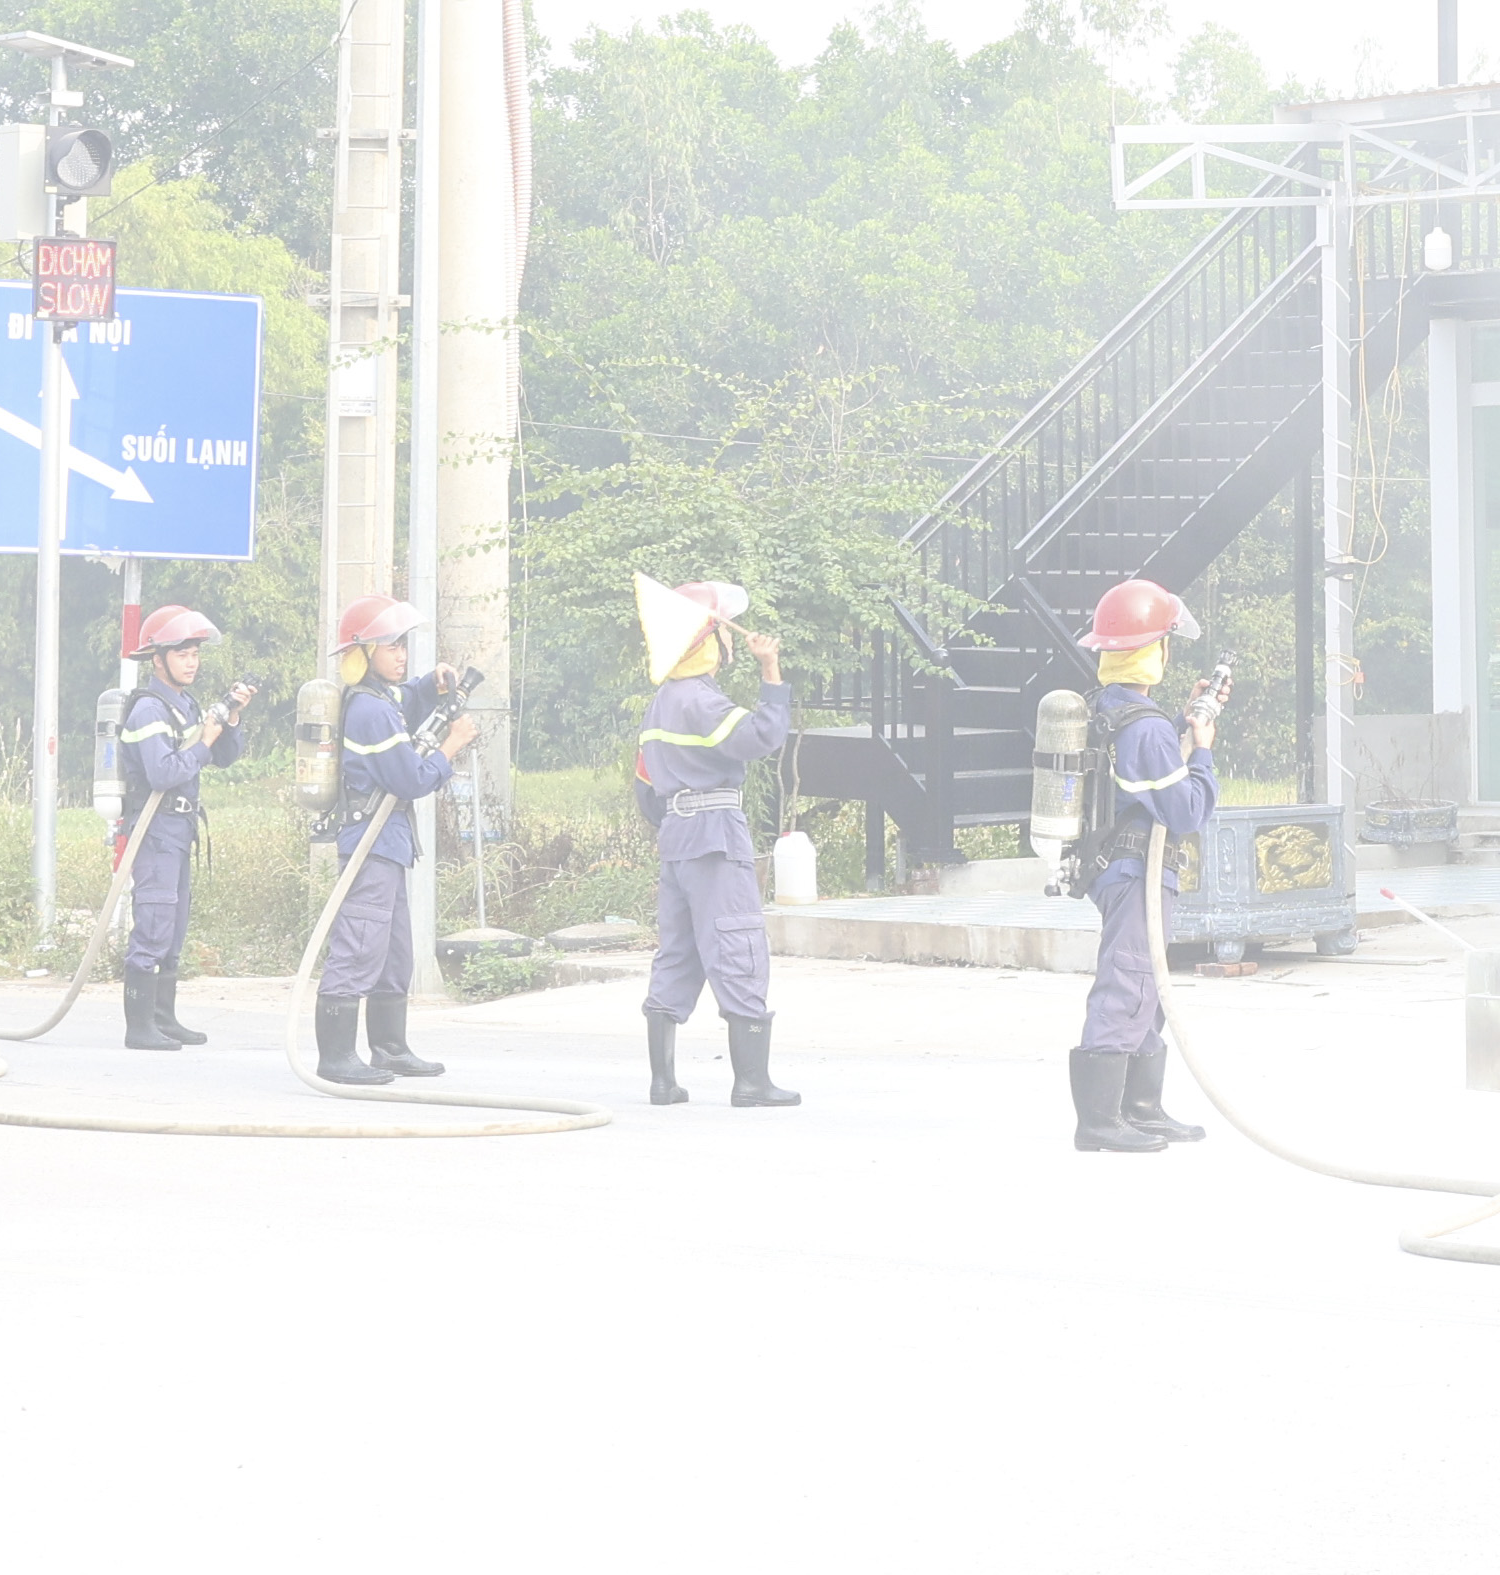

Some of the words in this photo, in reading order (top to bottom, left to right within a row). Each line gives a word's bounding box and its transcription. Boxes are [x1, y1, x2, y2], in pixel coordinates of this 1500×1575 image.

[38, 245, 58, 276] ĐI
[59, 242, 112, 280] CHẬM
[39, 282, 110, 316] SLOW
[7, 312, 33, 340] ĐI
[89, 311, 132, 352] NỘI
[121, 424, 176, 463] SUỐI
[186, 438, 248, 470] LẠNH
